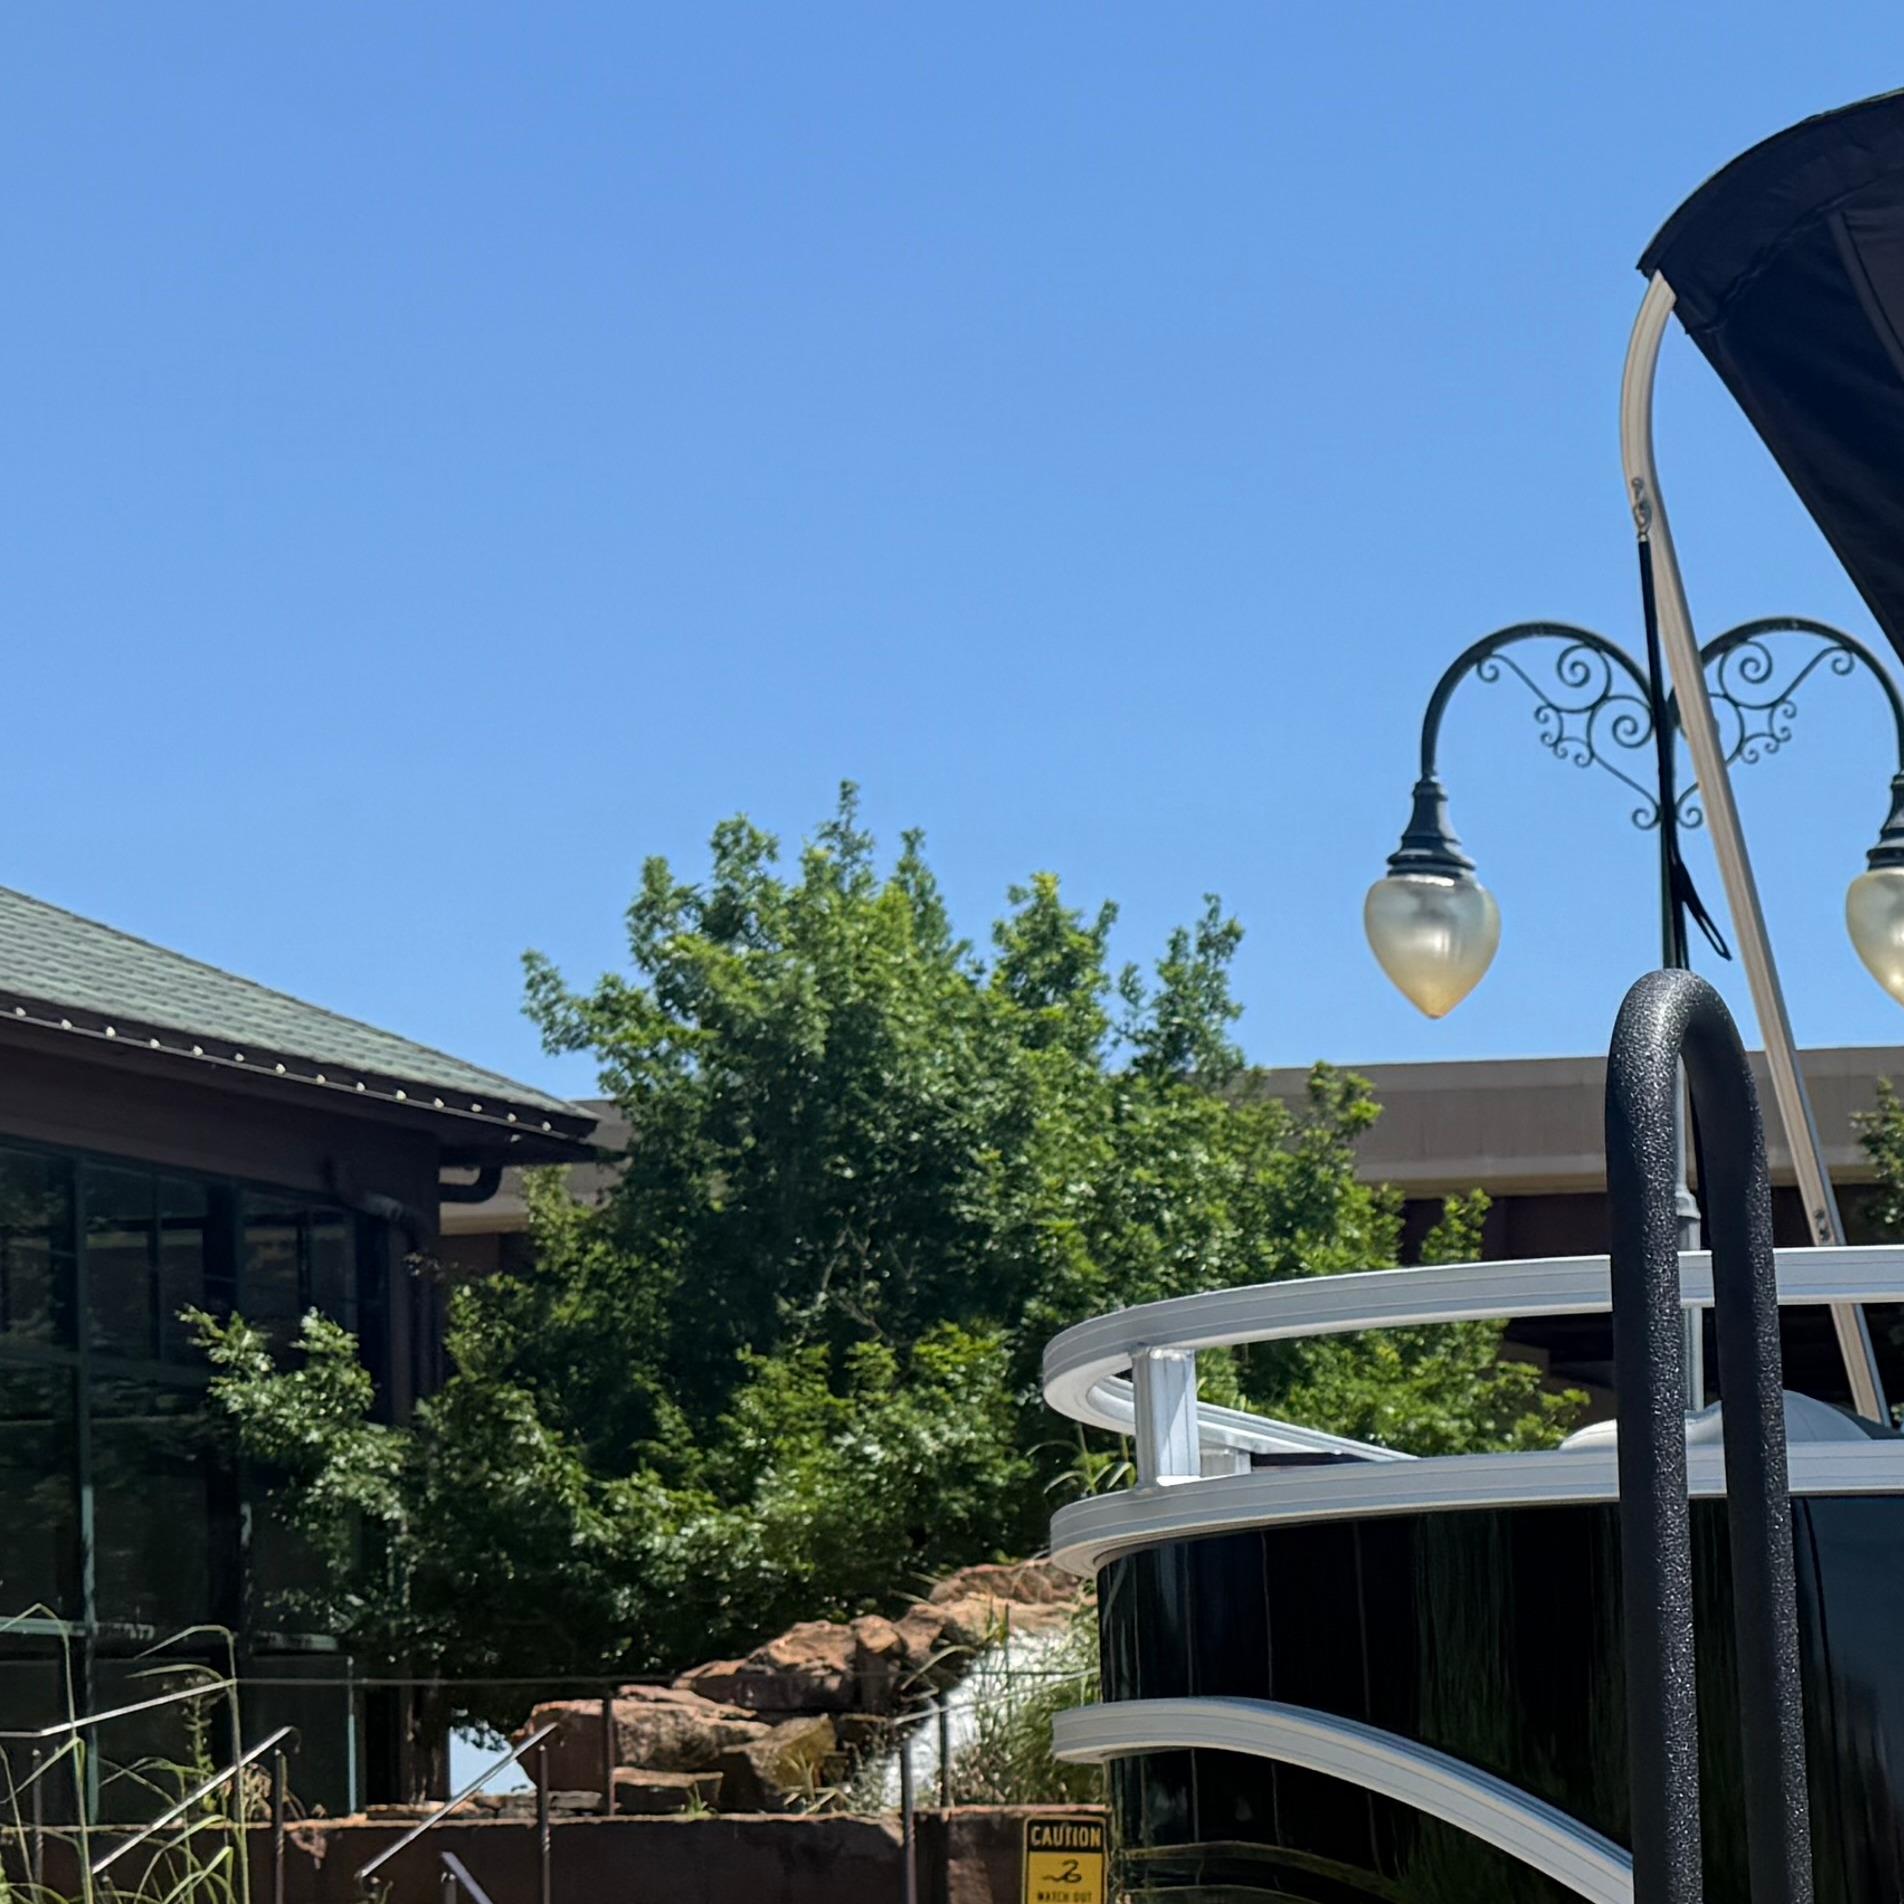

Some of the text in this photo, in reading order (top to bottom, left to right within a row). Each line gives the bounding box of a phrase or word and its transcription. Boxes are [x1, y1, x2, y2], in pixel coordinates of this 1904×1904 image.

[1031, 1826, 1101, 1847] CAUTION
[1037, 1890, 1092, 1904] WATCH OUT
